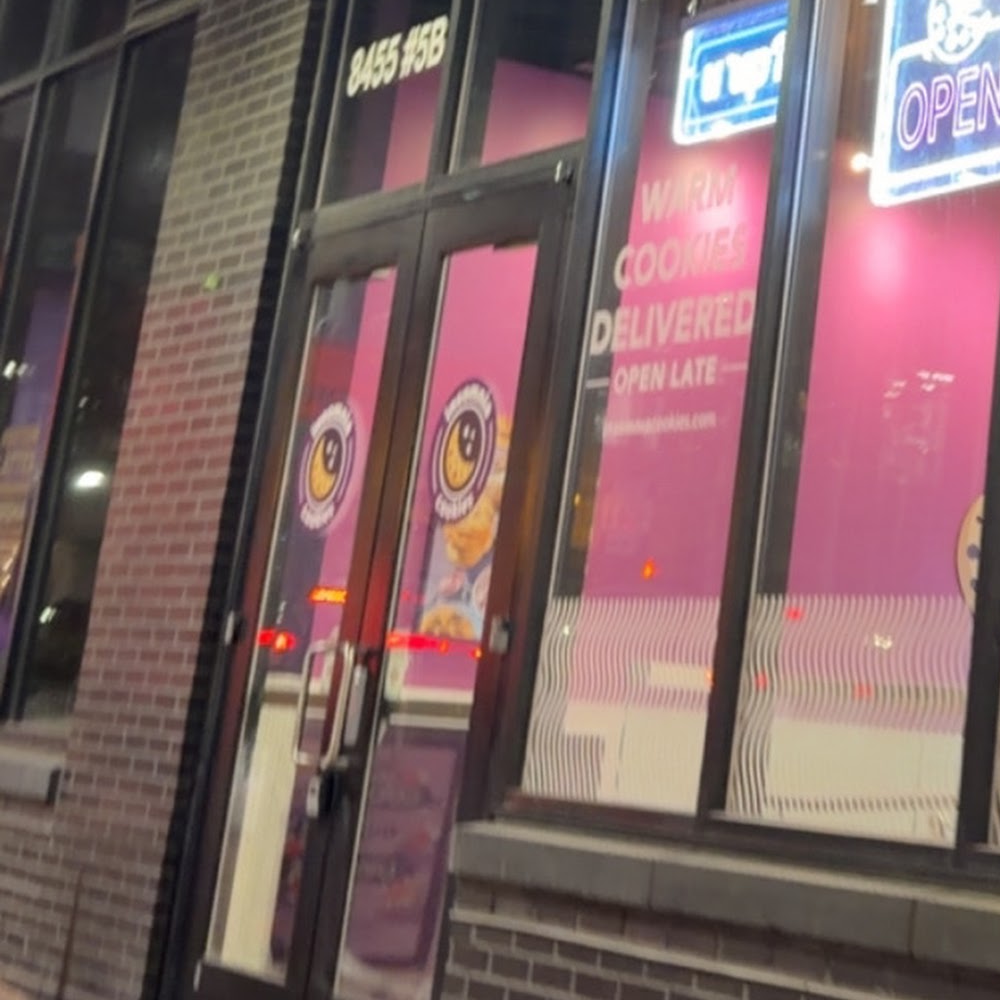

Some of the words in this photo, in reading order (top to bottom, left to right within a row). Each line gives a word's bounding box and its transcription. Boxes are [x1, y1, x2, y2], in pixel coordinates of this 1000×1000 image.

[346, 32, 403, 98] 8455
[399, 14, 449, 79] #5B
[640, 163, 738, 226] WARM
[613, 222, 747, 291] COOKIES
[589, 289, 757, 356] DELIVERED
[613, 360, 664, 394] OPEN
[670, 355, 718, 387] LATE
